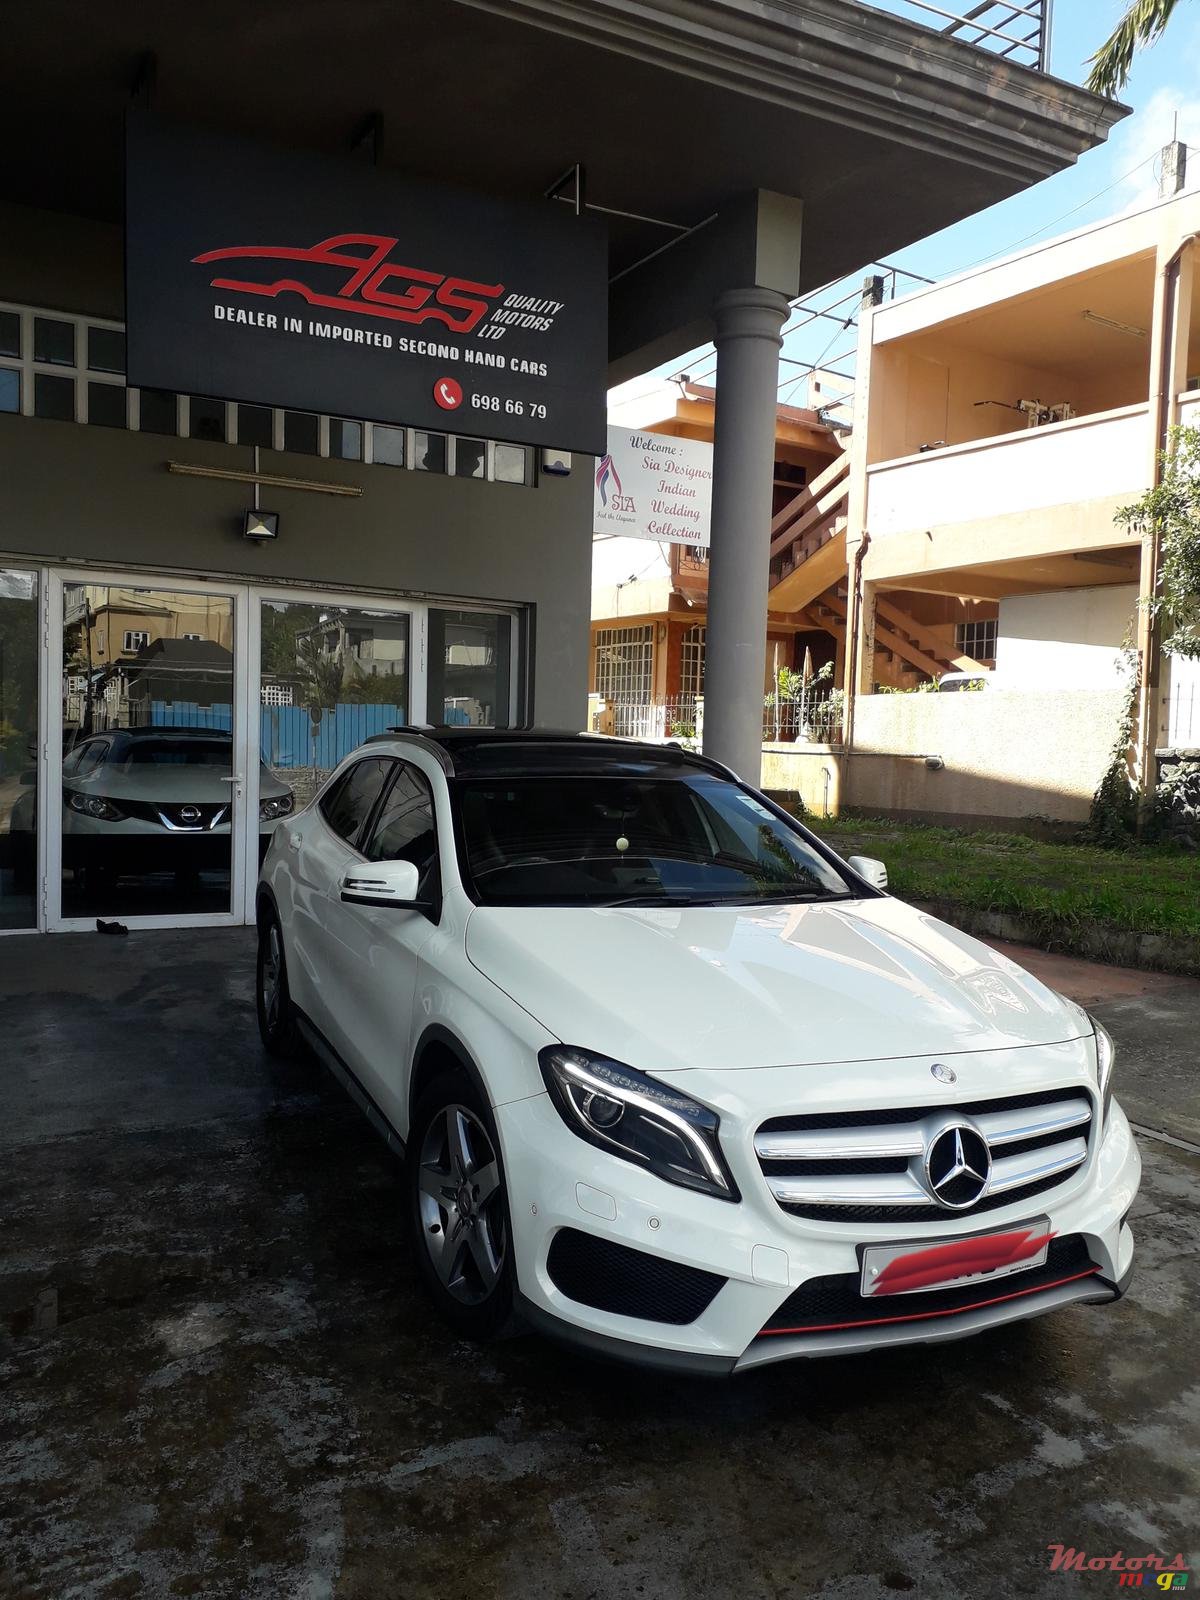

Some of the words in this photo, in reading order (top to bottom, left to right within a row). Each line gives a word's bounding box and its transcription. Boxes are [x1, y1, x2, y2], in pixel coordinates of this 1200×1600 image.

[306, 233, 505, 334] AGS
[503, 293, 565, 315] QUALITY
[490, 308, 554, 331] MOTORS
[214, 304, 277, 329] DEALER
[283, 316, 302, 333] IN
[308, 321, 393, 348] IMPORTED
[398, 337, 460, 361] SECOND
[464, 349, 506, 369] HAND
[510, 357, 548, 377] CARS
[477, 323, 507, 340] LTD
[471, 393, 500, 412] 698
[505, 399, 524, 416] 66
[529, 402, 547, 419] 79
[629, 435, 677, 456] Welcome
[641, 455, 661, 471] Sia
[664, 460, 713, 481] Designer
[657, 479, 697, 498] Indian
[611, 494, 636, 513] SIA
[650, 499, 701, 522] Wedding
[647, 520, 702, 540] Collection
